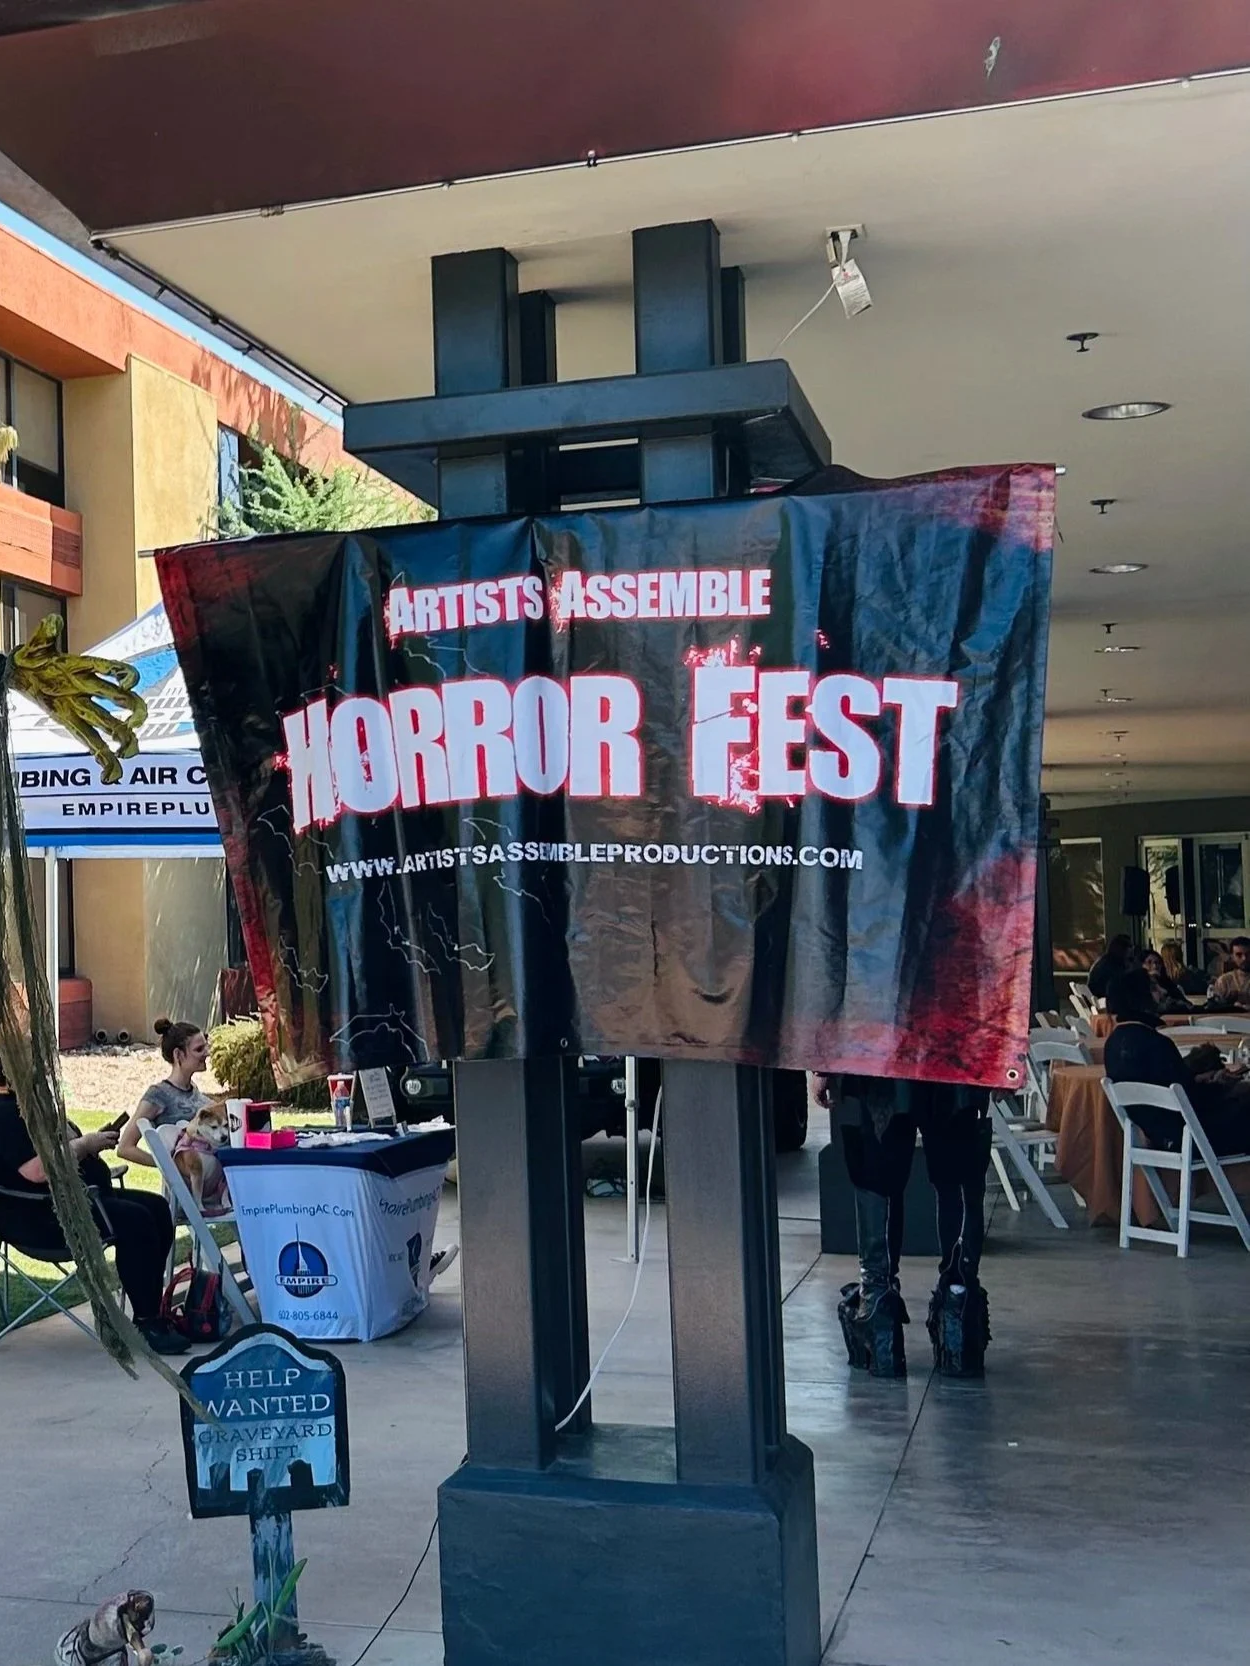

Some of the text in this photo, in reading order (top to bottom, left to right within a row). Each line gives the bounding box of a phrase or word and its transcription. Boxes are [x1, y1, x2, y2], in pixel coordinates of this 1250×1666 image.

[387, 568, 772, 636] ARTISTS ASSEMBLE
[281, 665, 959, 835] HORROR FEST
[129, 766, 178, 785] AIR
[325, 842, 864, 884] WWW.ARTISTSASSEMBLEPRODUCTIONS.COM
[279, 1276, 329, 1286] EMPIRE
[224, 1368, 301, 1390] HELP
[200, 1393, 331, 1419] WANTED
[198, 1423, 333, 1445] GRAVEYARD
[236, 1445, 298, 1463] SHIFT
